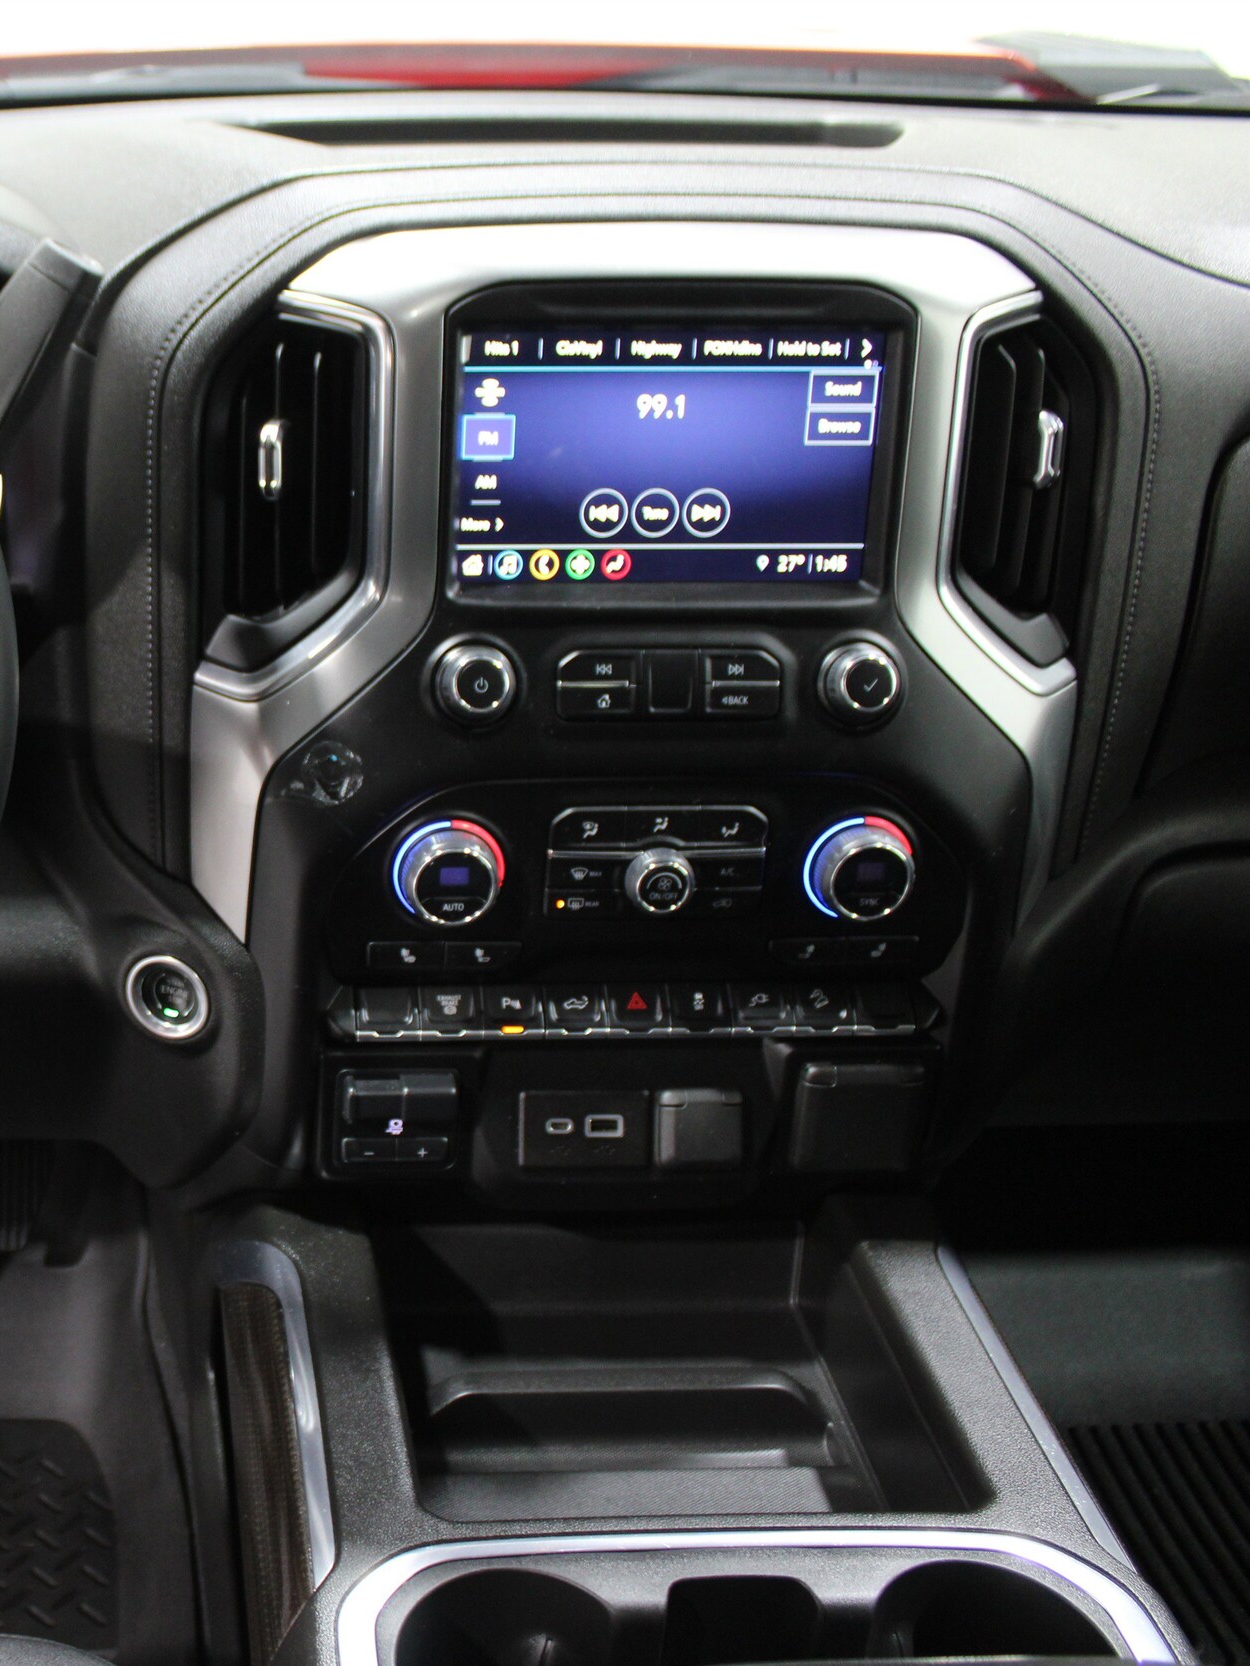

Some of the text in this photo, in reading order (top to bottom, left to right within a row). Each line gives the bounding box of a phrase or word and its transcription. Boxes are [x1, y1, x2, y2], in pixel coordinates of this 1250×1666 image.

[631, 340, 682, 359] Highway
[777, 341, 842, 357] Hold to Set
[824, 381, 862, 397] Sound
[636, 394, 686, 419] 99.1
[818, 418, 862, 434] Browse
[478, 431, 499, 446] FM
[474, 474, 497, 490] AM
[642, 506, 669, 521] Tune
[461, 517, 491, 532] More
[815, 554, 848, 572] 1:45
[728, 696, 748, 705] BACK
[650, 891, 680, 900] ON/OFF
[443, 903, 464, 911] AUTO
